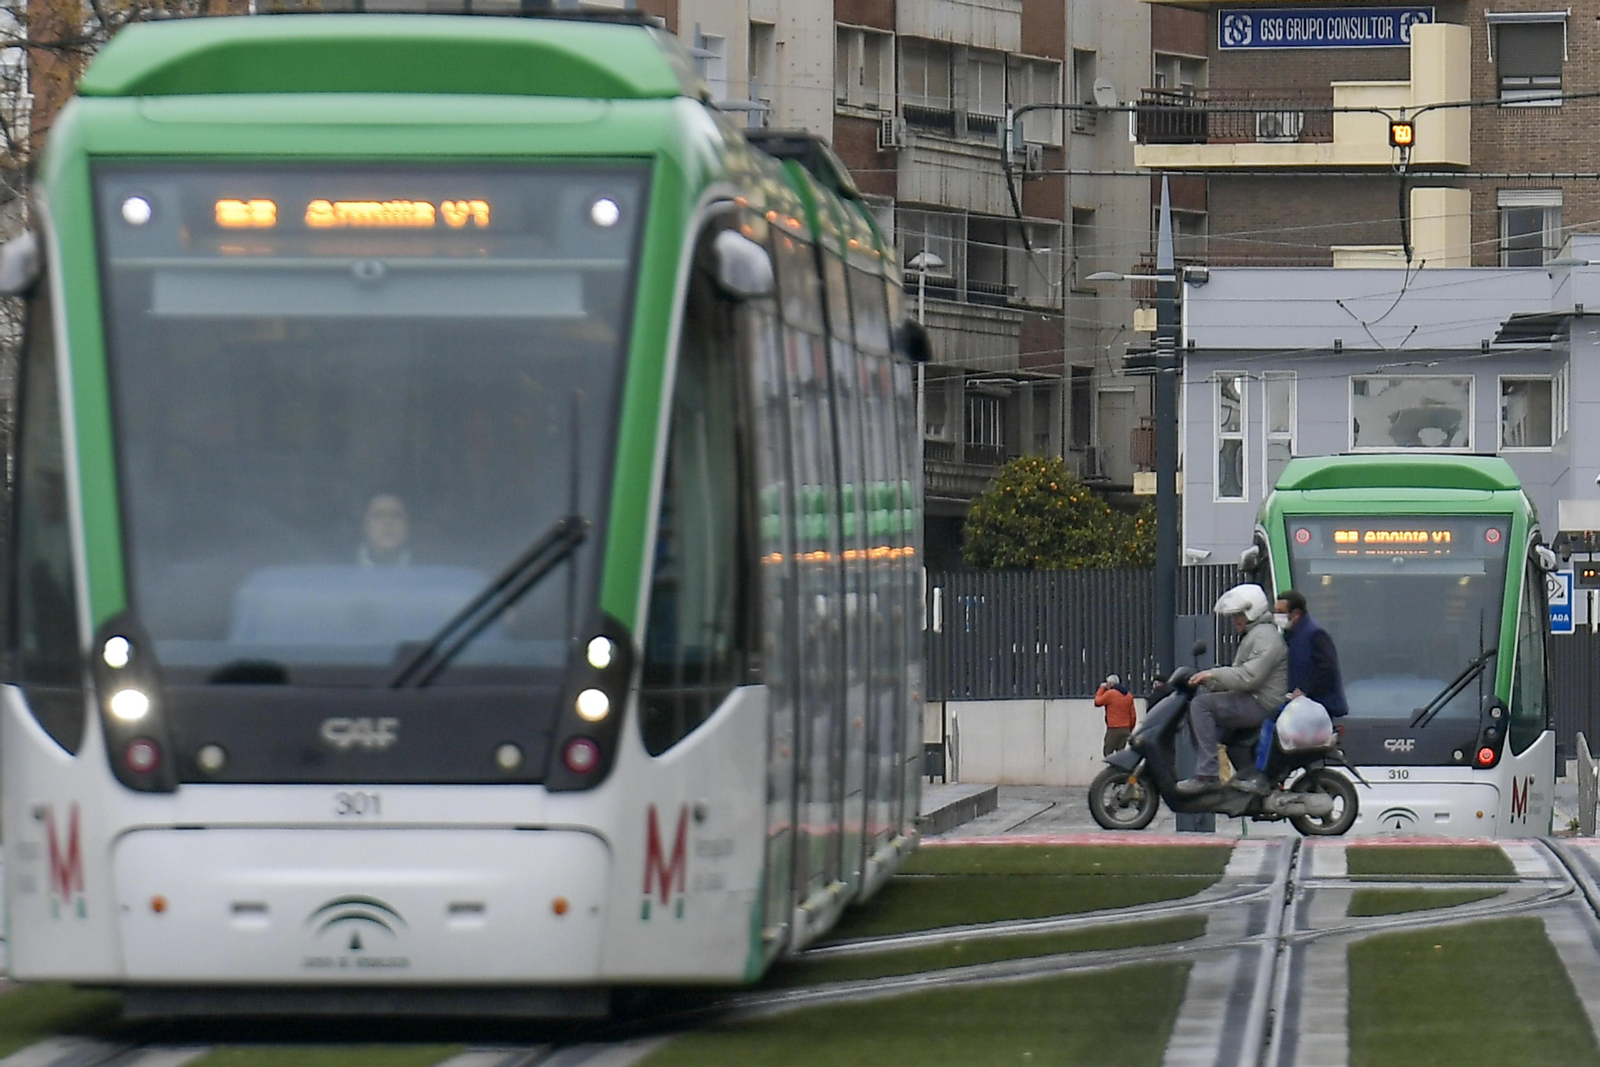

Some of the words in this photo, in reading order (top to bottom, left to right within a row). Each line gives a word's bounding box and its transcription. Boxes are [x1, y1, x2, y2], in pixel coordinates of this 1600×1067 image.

[1260, 18, 1283, 41] GSG
[1286, 17, 1324, 40] GRUPO
[1326, 16, 1394, 40] CONSULTOR
[1550, 613, 1570, 622] ADA
[1384, 739, 1415, 751] CAF
[1389, 769, 1409, 780] 310
[335, 790, 382, 817] 301
